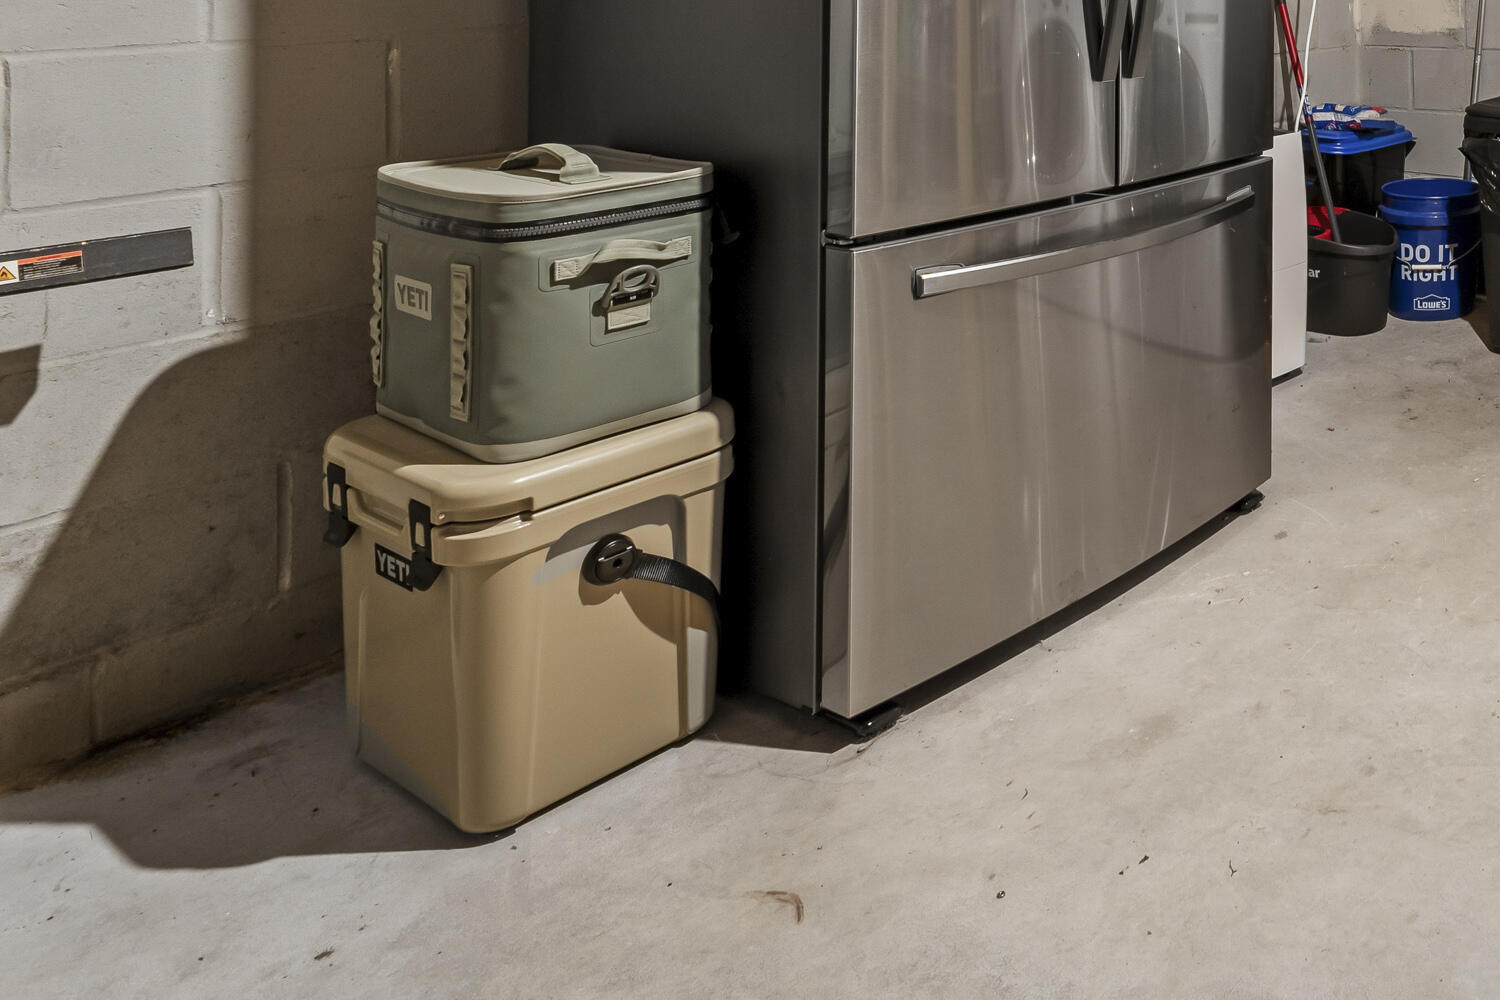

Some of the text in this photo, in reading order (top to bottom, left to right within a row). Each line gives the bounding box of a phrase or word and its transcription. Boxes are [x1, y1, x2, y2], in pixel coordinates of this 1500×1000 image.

[1400, 243, 1459, 263] DO IT
[1401, 264, 1458, 282] RIGHT
[398, 283, 429, 314] YETI
[1417, 300, 1447, 309] LOWE'S
